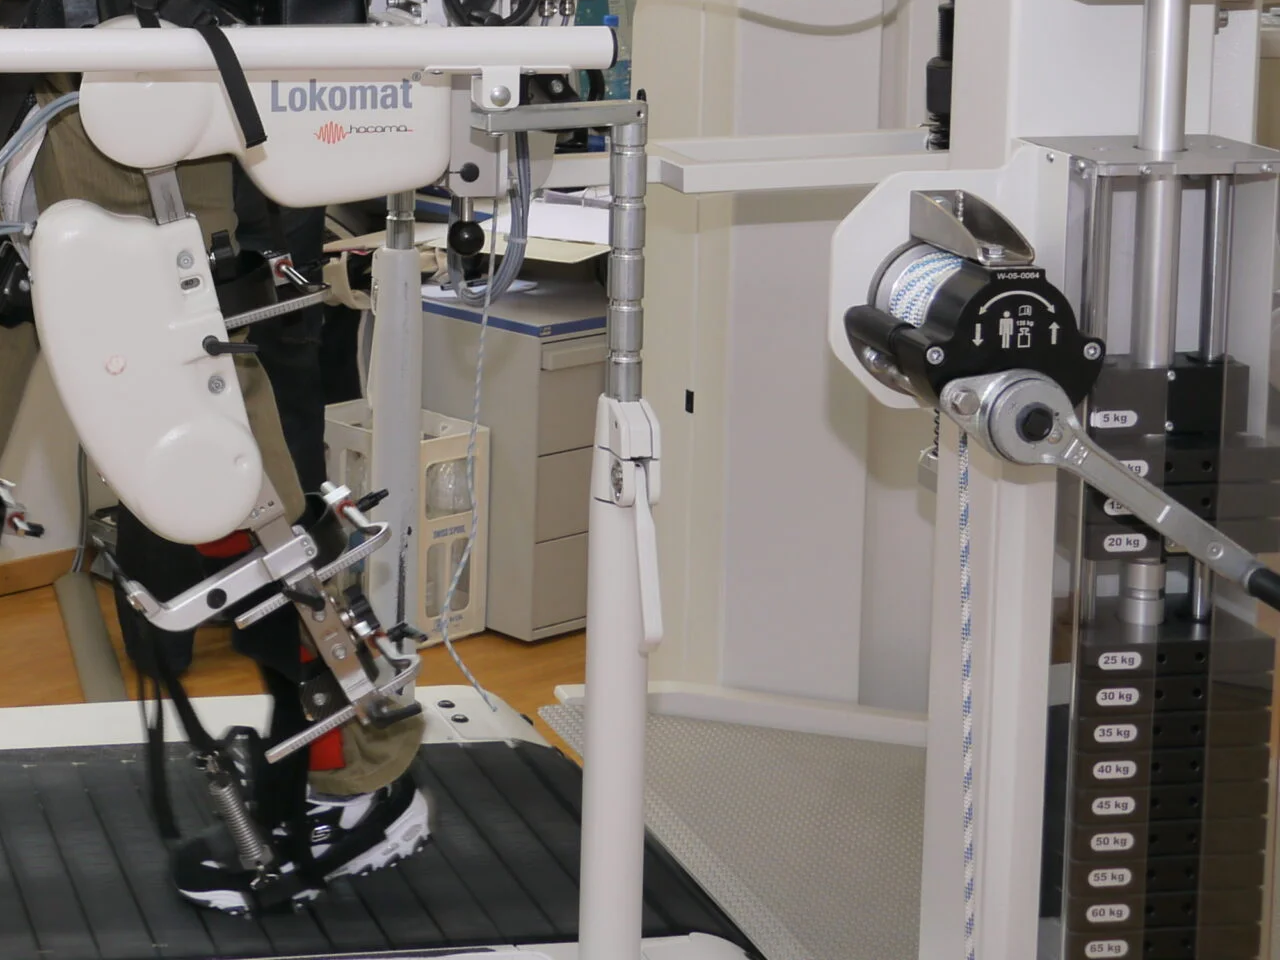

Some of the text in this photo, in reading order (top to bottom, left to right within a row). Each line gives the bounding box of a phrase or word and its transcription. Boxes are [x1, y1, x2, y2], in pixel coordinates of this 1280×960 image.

[1103, 413, 1128, 424] 5 kg
[1108, 537, 1140, 549] 20 kg
[1103, 654, 1135, 666] 25 kg
[1100, 690, 1133, 702] 30 kg
[1098, 727, 1131, 739] 35 kg
[1097, 763, 1130, 775] 40 kg
[1096, 799, 1129, 811] 45 kg
[1095, 836, 1128, 847] 50 kg
[1093, 871, 1125, 883] 55 kg
[1108, 907, 1123, 919] kg
[1107, 943, 1122, 954] kg
